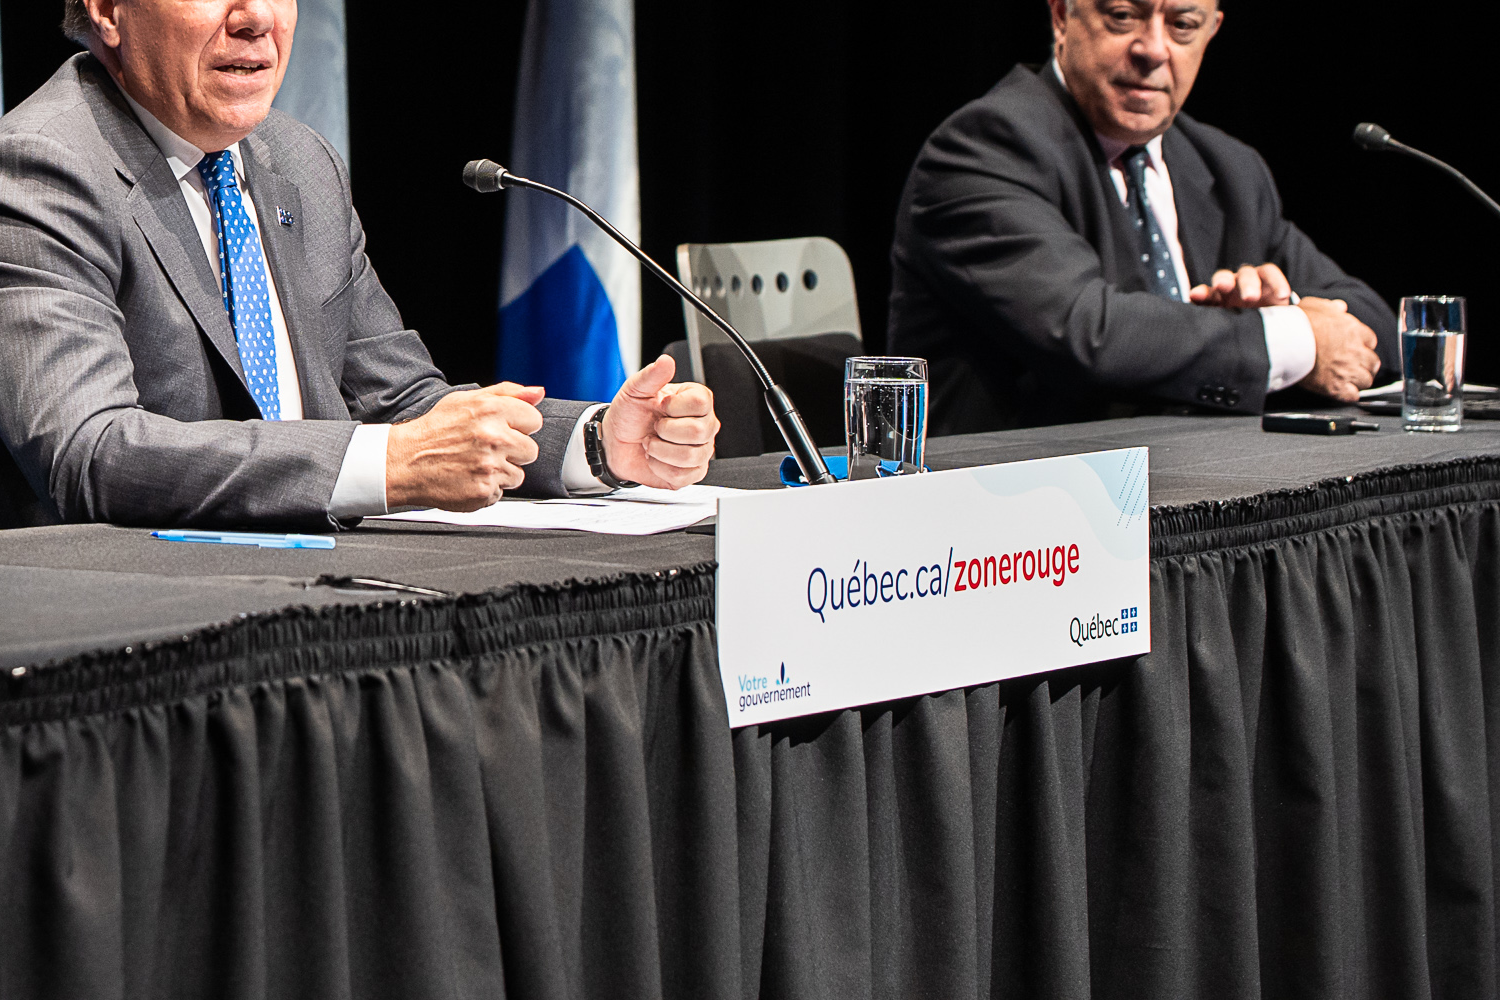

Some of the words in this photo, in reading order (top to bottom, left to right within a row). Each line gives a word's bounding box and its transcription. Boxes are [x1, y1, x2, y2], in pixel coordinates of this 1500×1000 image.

[807, 542, 1080, 623] Québec.ca/zonerouge
[1069, 614, 1119, 647] Québec
[738, 674, 767, 692] Votre
[739, 682, 811, 712] gouvernement
